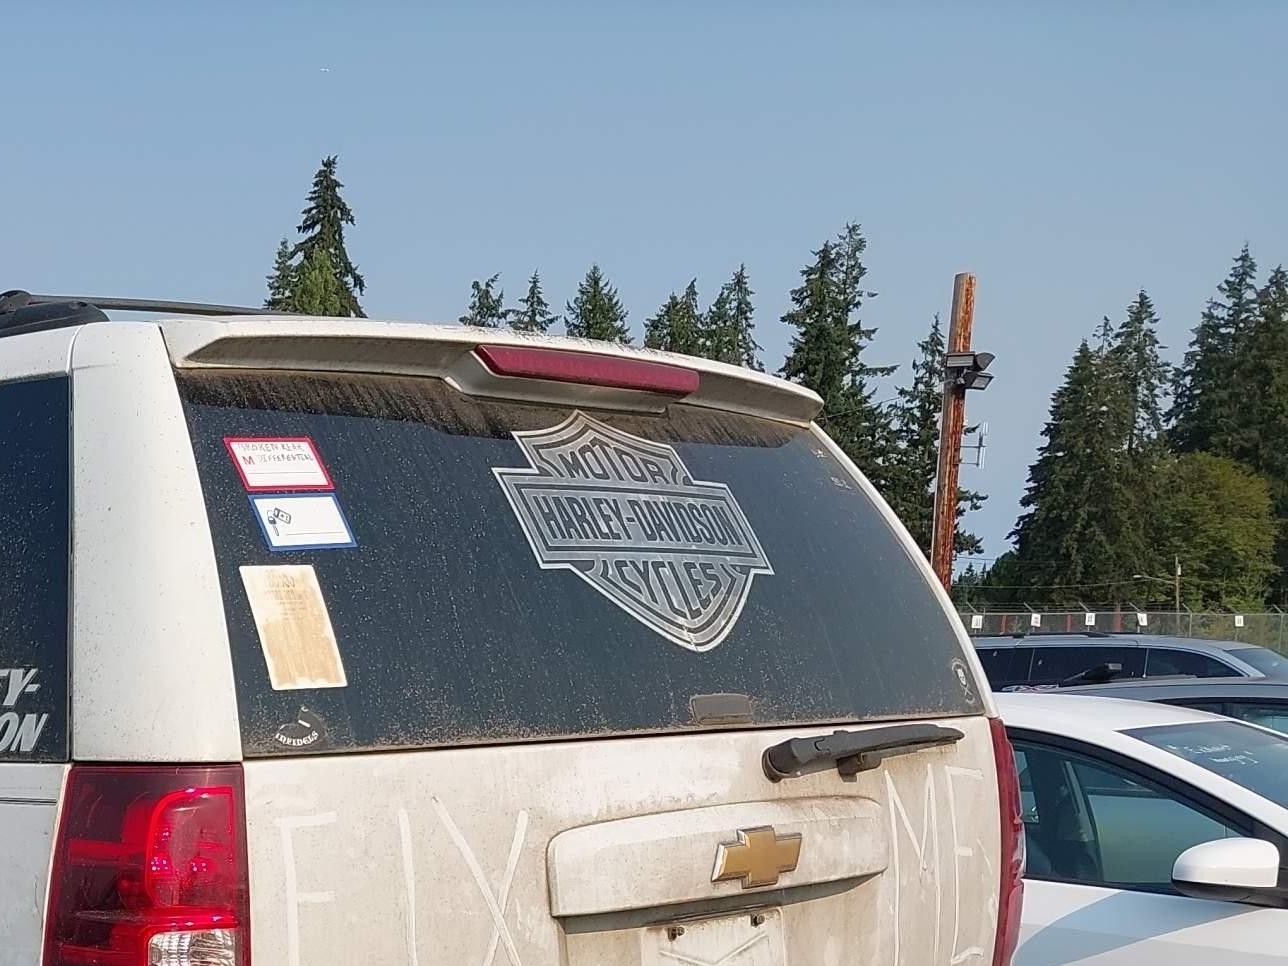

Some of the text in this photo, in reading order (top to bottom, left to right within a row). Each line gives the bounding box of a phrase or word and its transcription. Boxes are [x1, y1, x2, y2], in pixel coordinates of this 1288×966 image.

[557, 437, 670, 485] MOTOR
[532, 494, 744, 546] HARLEY-DAVIDSON
[614, 559, 724, 620] CYCLES
